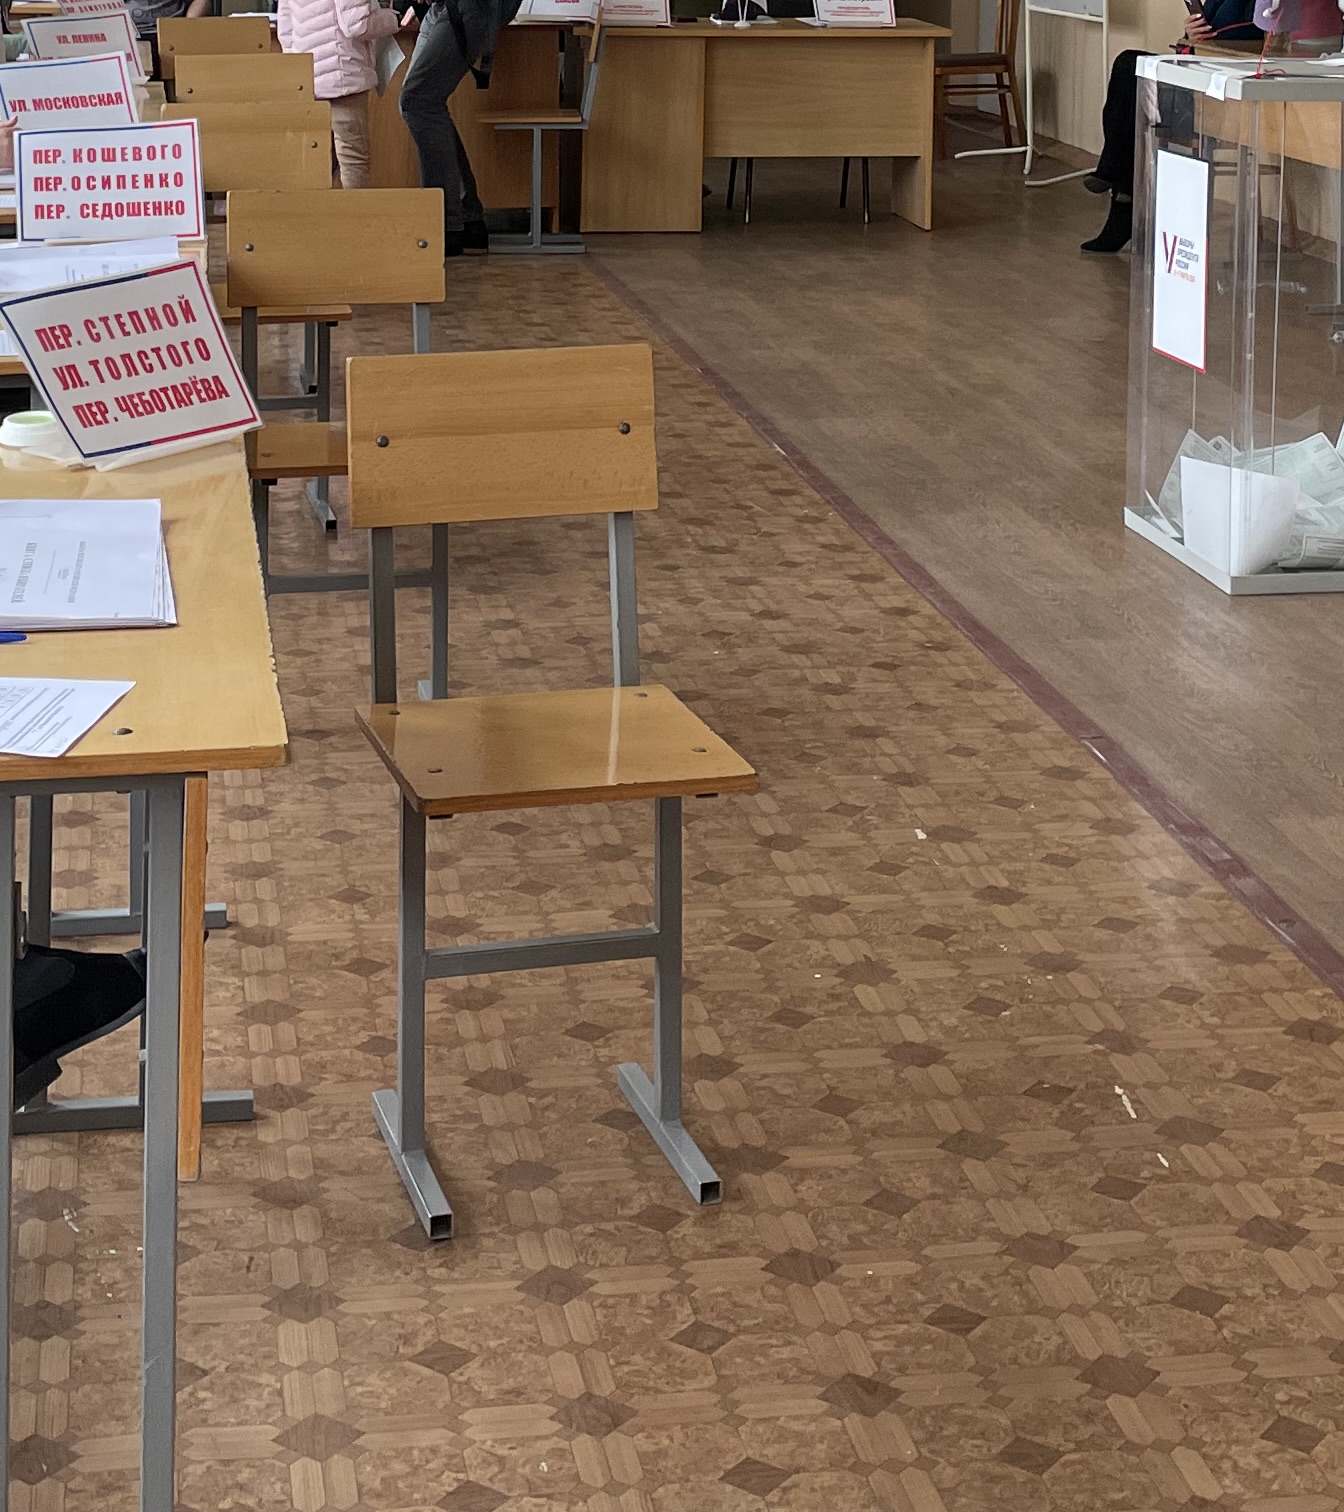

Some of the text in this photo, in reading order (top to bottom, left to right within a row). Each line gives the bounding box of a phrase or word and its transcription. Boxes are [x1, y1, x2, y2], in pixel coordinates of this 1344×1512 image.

[9, 91, 125, 113] УЛ. МОСКОВСКАЯ
[33, 143, 183, 165] ПЕР. КОШЕВОГО
[33, 172, 184, 192] ПЕР. ОСИПЕНКО
[34, 200, 186, 221] ПЕР. СЕДОШЕНКО
[34, 294, 197, 353] ПЕР. СТЕПНОЙ
[52, 337, 212, 391] УЛ. ТОЛСТОГО
[72, 375, 230, 429] ПЕР. ЧЕБОТАРЁВА
